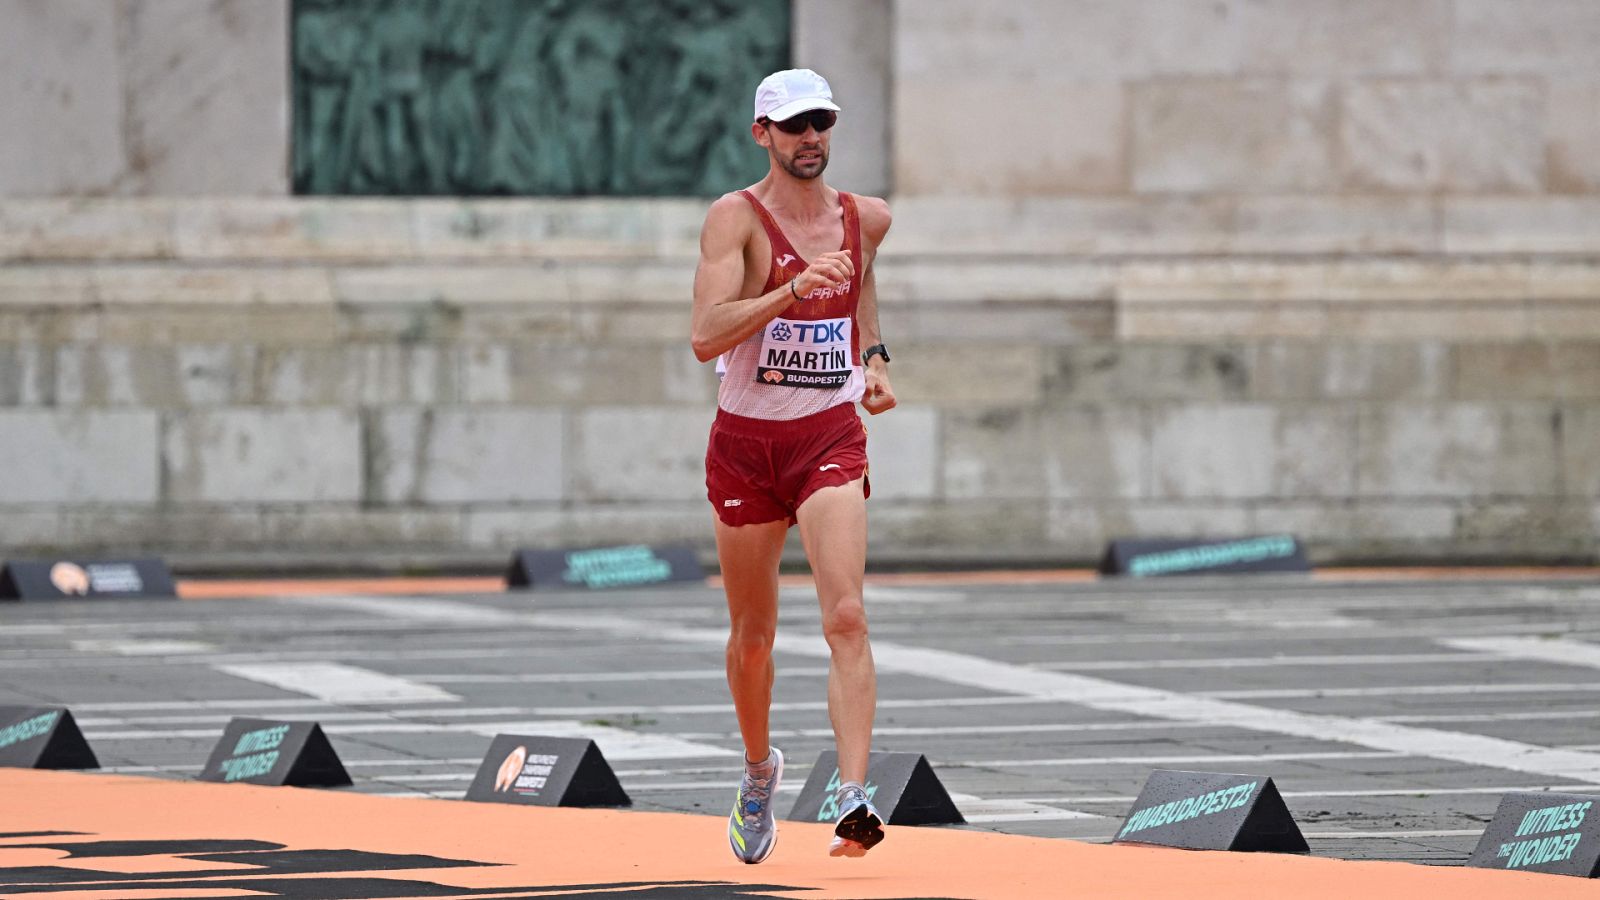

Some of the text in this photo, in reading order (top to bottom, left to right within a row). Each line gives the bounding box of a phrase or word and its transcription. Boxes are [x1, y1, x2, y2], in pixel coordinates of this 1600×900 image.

[793, 321, 846, 344] TDK
[766, 346, 846, 370] MARTÍN
[1119, 781, 1257, 839] #WABUDAPEST23
[1515, 801, 1592, 837] WITNESS
[1497, 832, 1582, 868] THE WONDER
